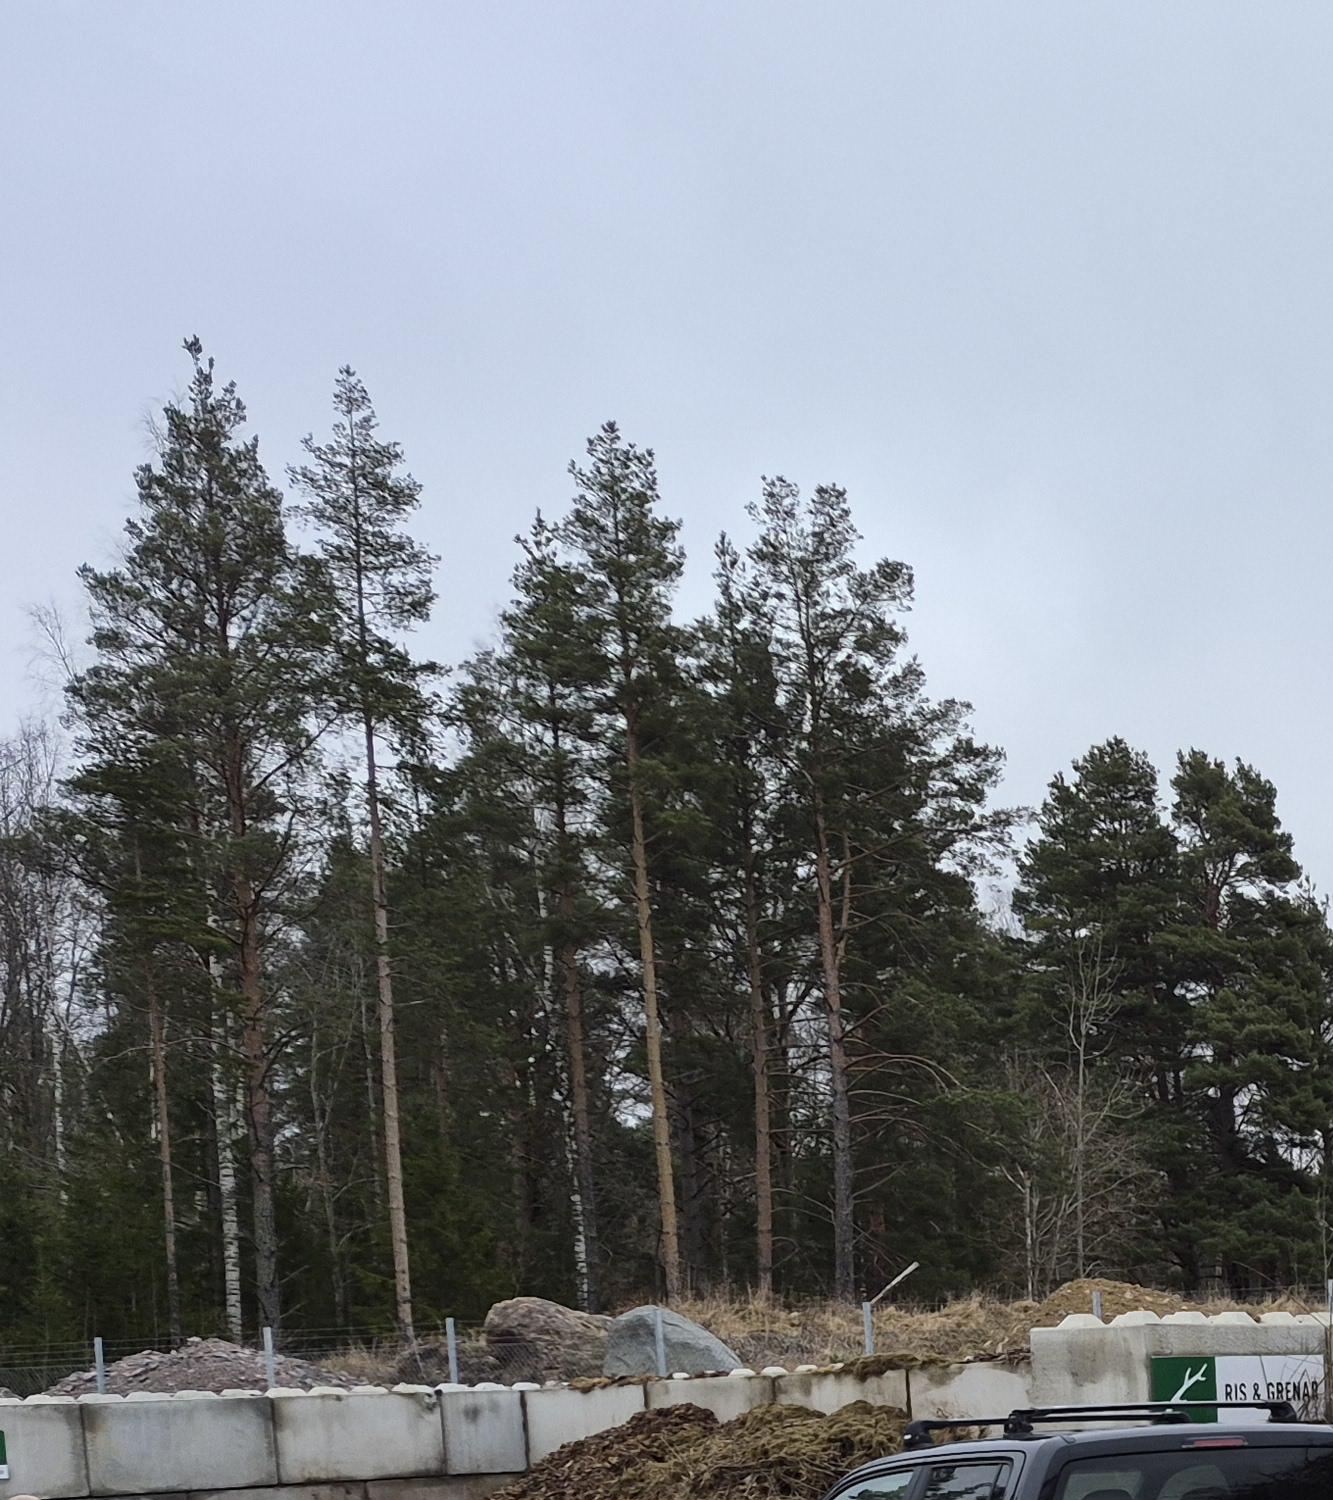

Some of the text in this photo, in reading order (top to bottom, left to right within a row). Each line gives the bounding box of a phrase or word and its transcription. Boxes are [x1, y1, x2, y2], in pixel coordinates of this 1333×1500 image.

[1225, 1381, 1319, 1402] RIS & GRENAR
